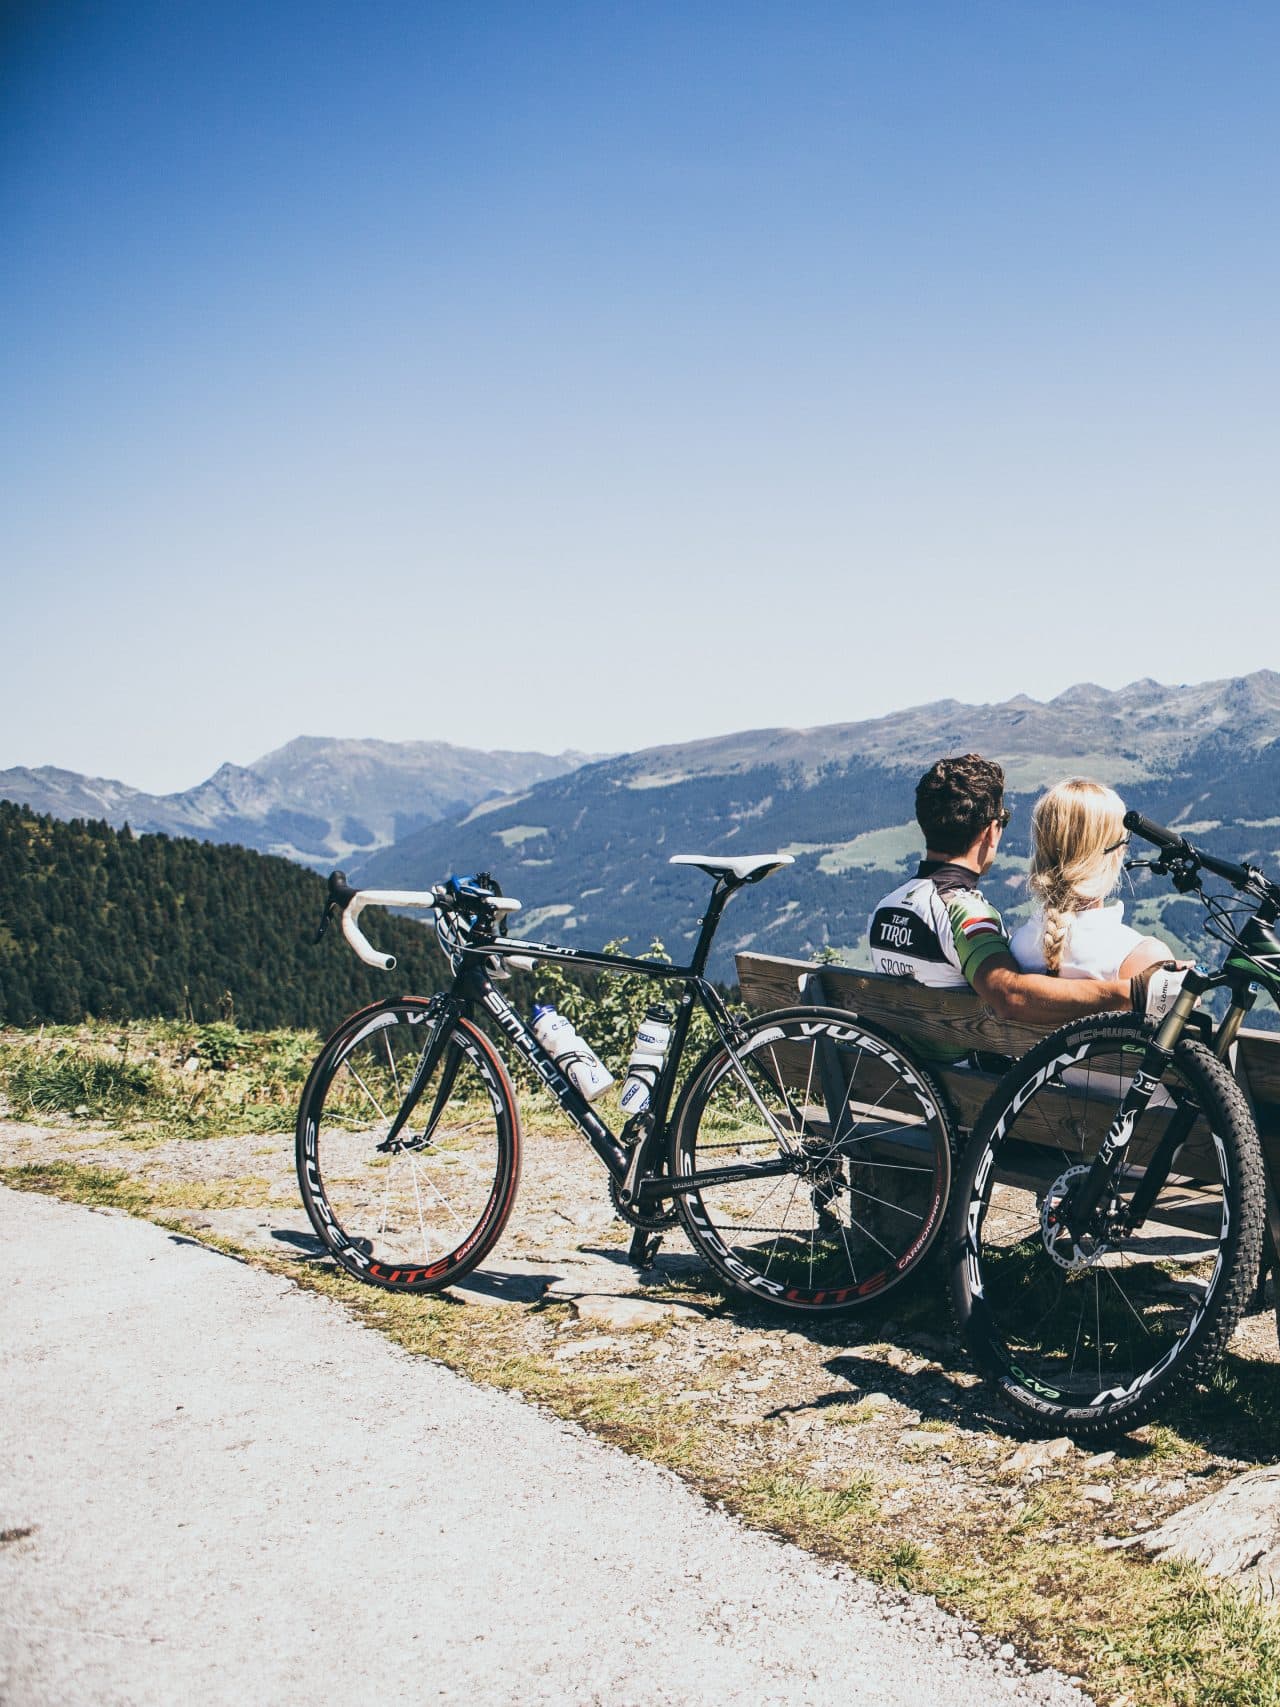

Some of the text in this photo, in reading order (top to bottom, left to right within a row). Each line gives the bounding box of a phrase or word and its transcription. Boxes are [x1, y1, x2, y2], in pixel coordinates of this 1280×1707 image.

[880, 923, 914, 948] TIROL
[891, 914, 910, 926] TEAM
[483, 991, 570, 1096] SIMPLON
[800, 1022, 937, 1121] VUELTA
[967, 1043, 1092, 1300] EASTON
[896, 1194, 940, 1271] CARBONPRO
[1095, 1131, 1231, 1407] EASTON
[1009, 1365, 1061, 1400] EA70
